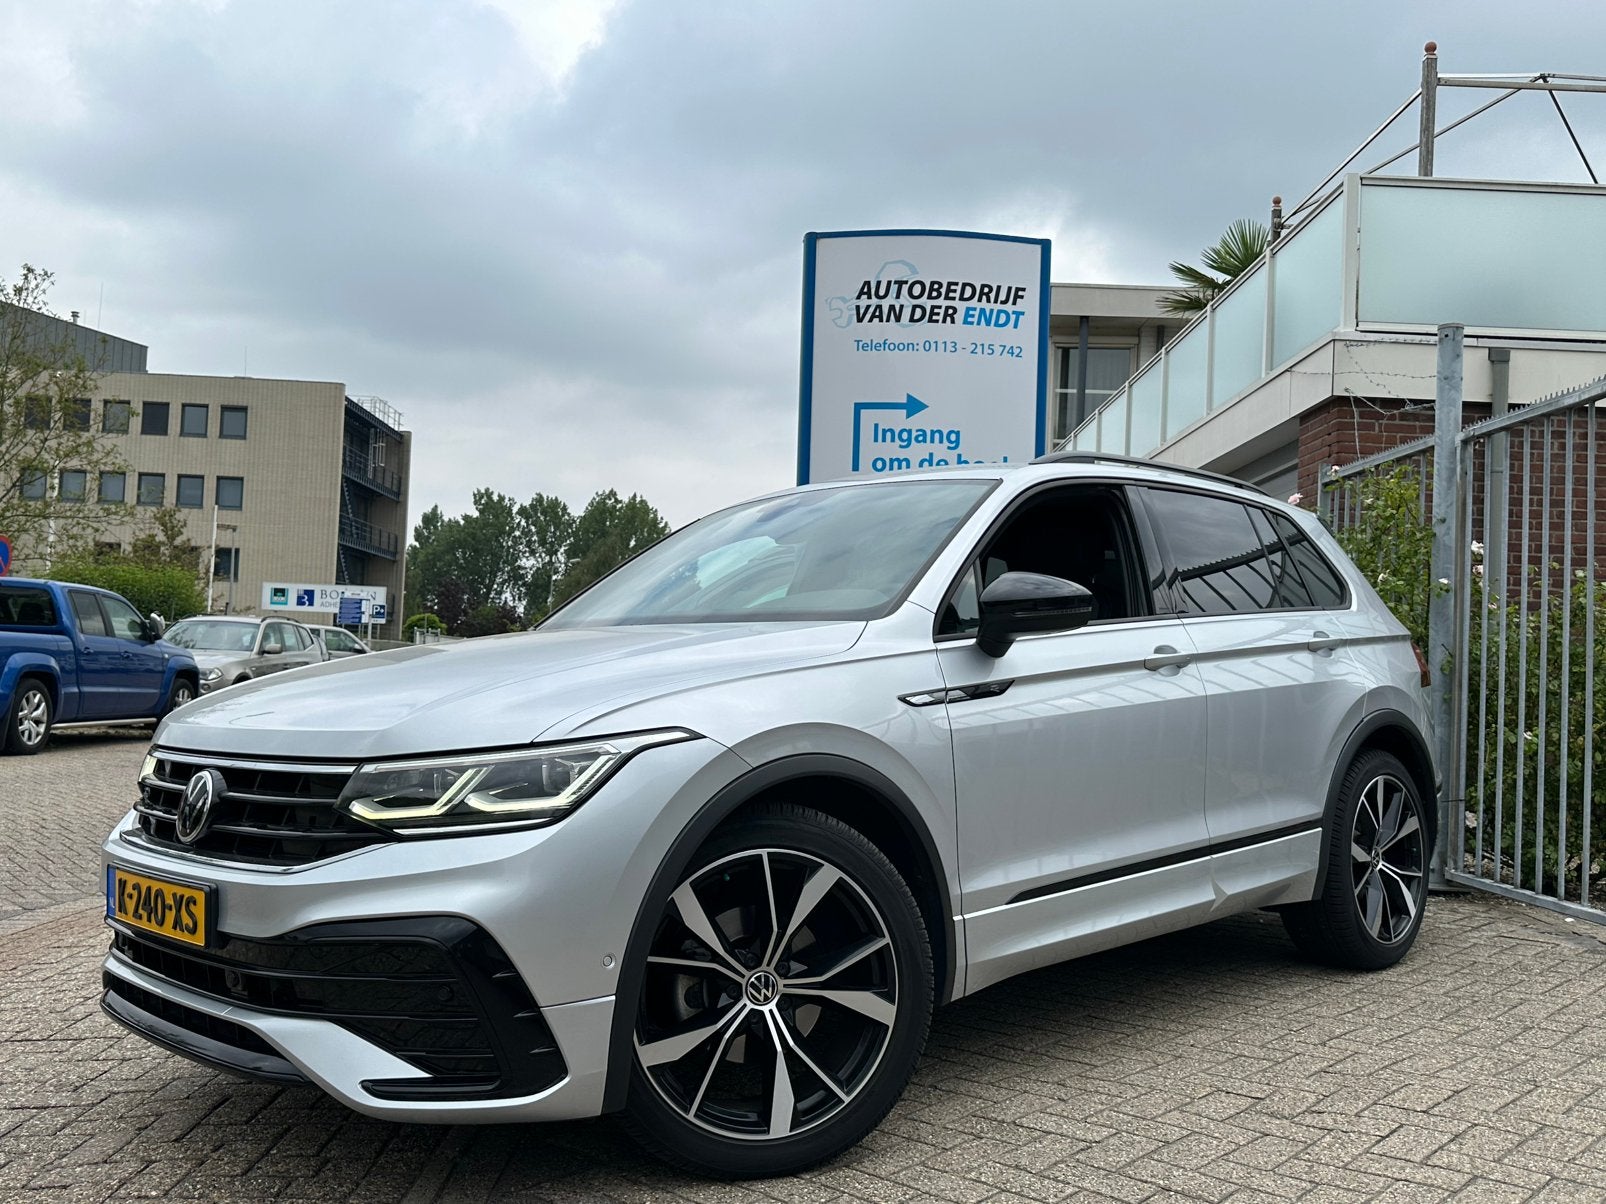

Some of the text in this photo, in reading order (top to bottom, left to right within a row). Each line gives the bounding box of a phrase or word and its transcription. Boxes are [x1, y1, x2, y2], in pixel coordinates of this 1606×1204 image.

[855, 279, 1027, 306] AUTOBEDRIJF
[854, 304, 1025, 329] VAN DER ENDT
[854, 338, 920, 352] Telefoon:
[922, 340, 958, 353] 0113
[969, 342, 996, 356] 215
[999, 344, 1023, 358] 742
[873, 423, 961, 451] Ingang
[871, 456, 911, 473] om
[117, 877, 198, 936] K-240-XS
